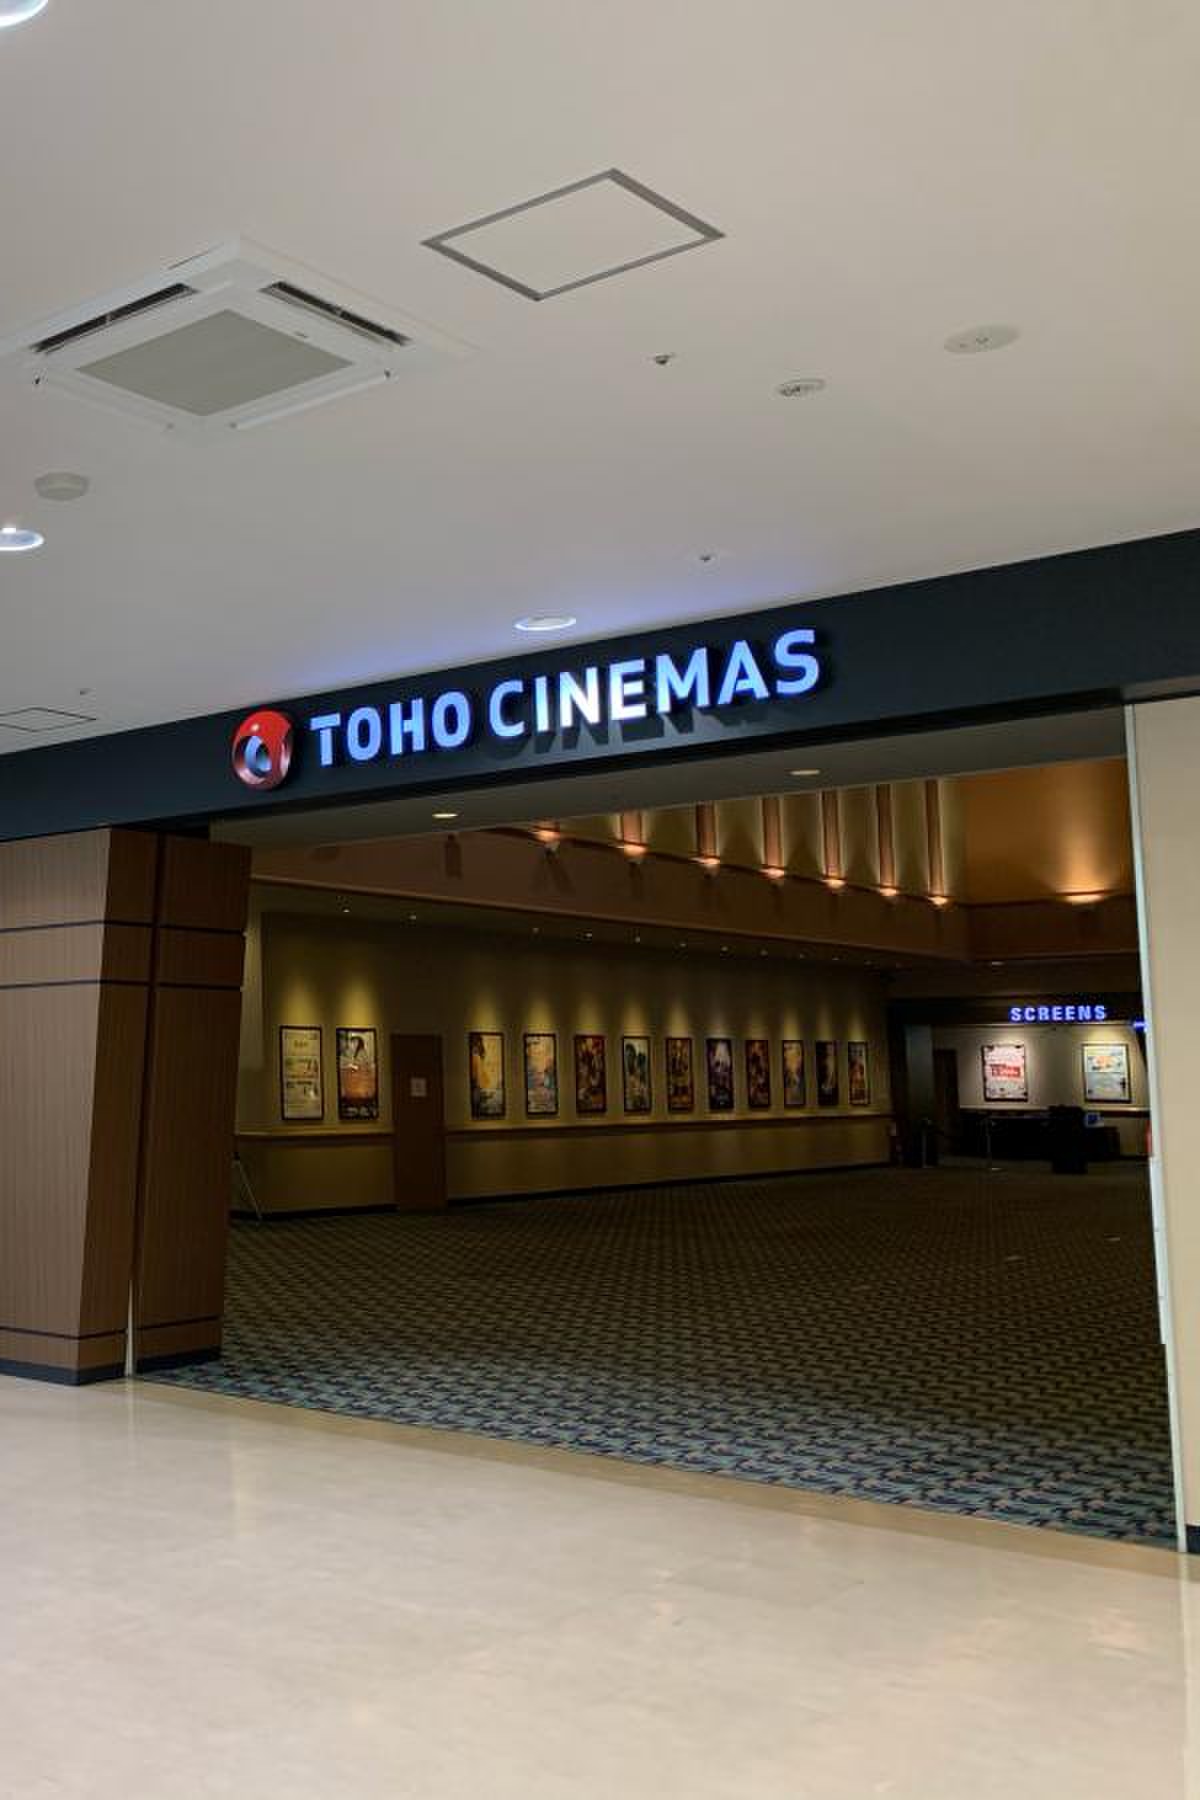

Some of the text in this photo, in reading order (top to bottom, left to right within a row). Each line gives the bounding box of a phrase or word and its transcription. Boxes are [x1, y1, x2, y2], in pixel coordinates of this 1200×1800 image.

[310, 629, 820, 767] TOHO CINEMAS
[1010, 1005, 1106, 1021] SCREENS
